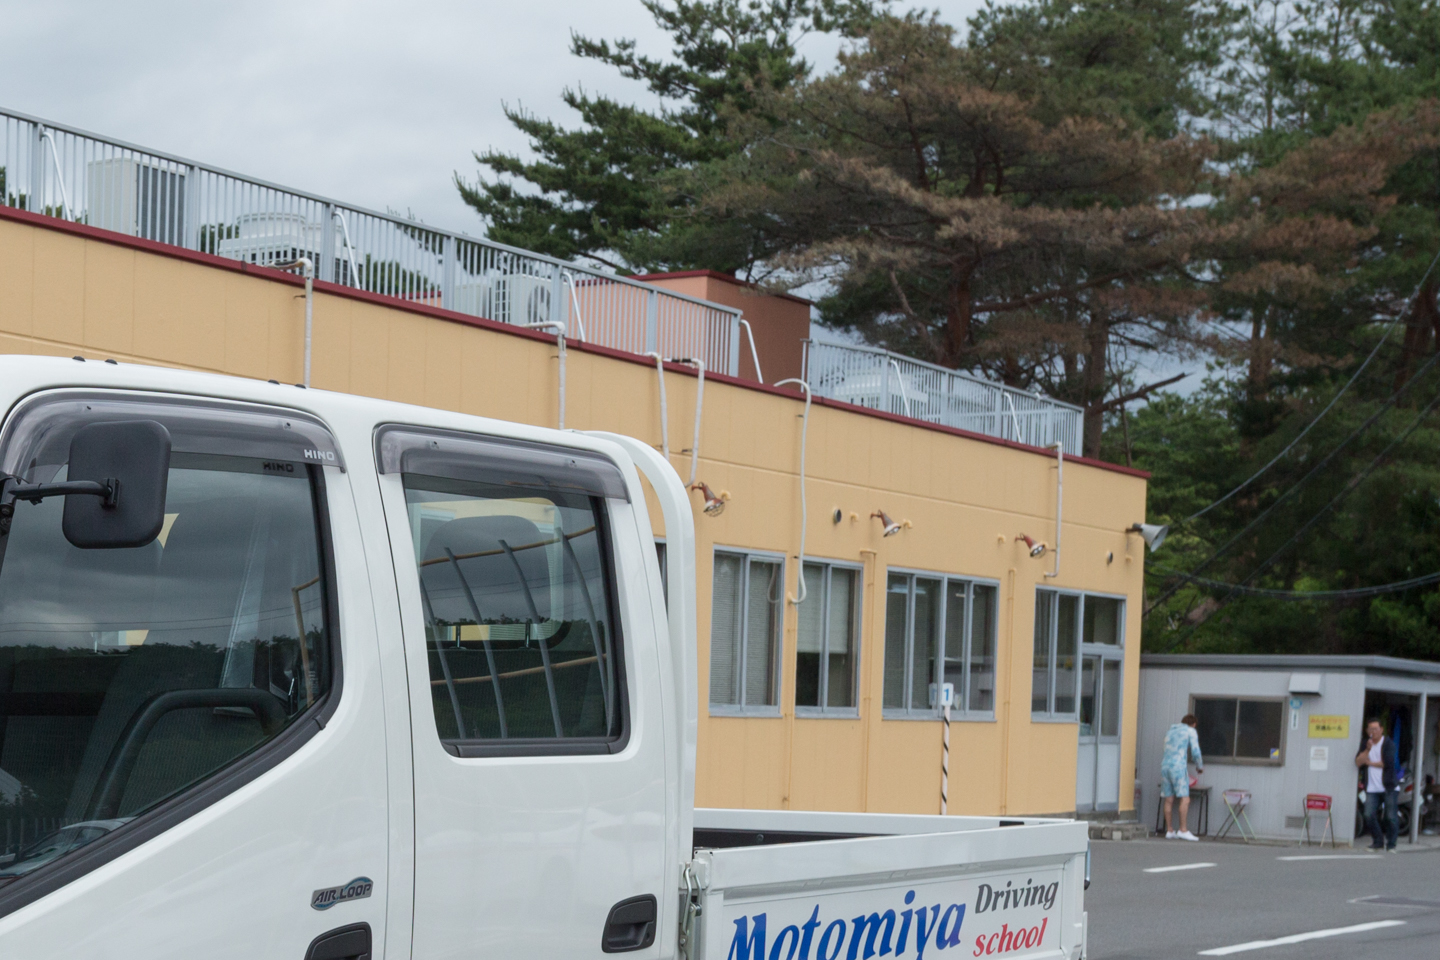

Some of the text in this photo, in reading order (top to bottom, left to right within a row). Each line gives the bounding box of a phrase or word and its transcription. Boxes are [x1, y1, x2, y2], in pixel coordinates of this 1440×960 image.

[303, 448, 335, 461] HINO
[262, 461, 295, 473] HINO
[943, 687, 950, 702] 1
[313, 883, 372, 905] AIR LOOP
[973, 876, 1059, 915] Driving
[972, 917, 1048, 958] school
